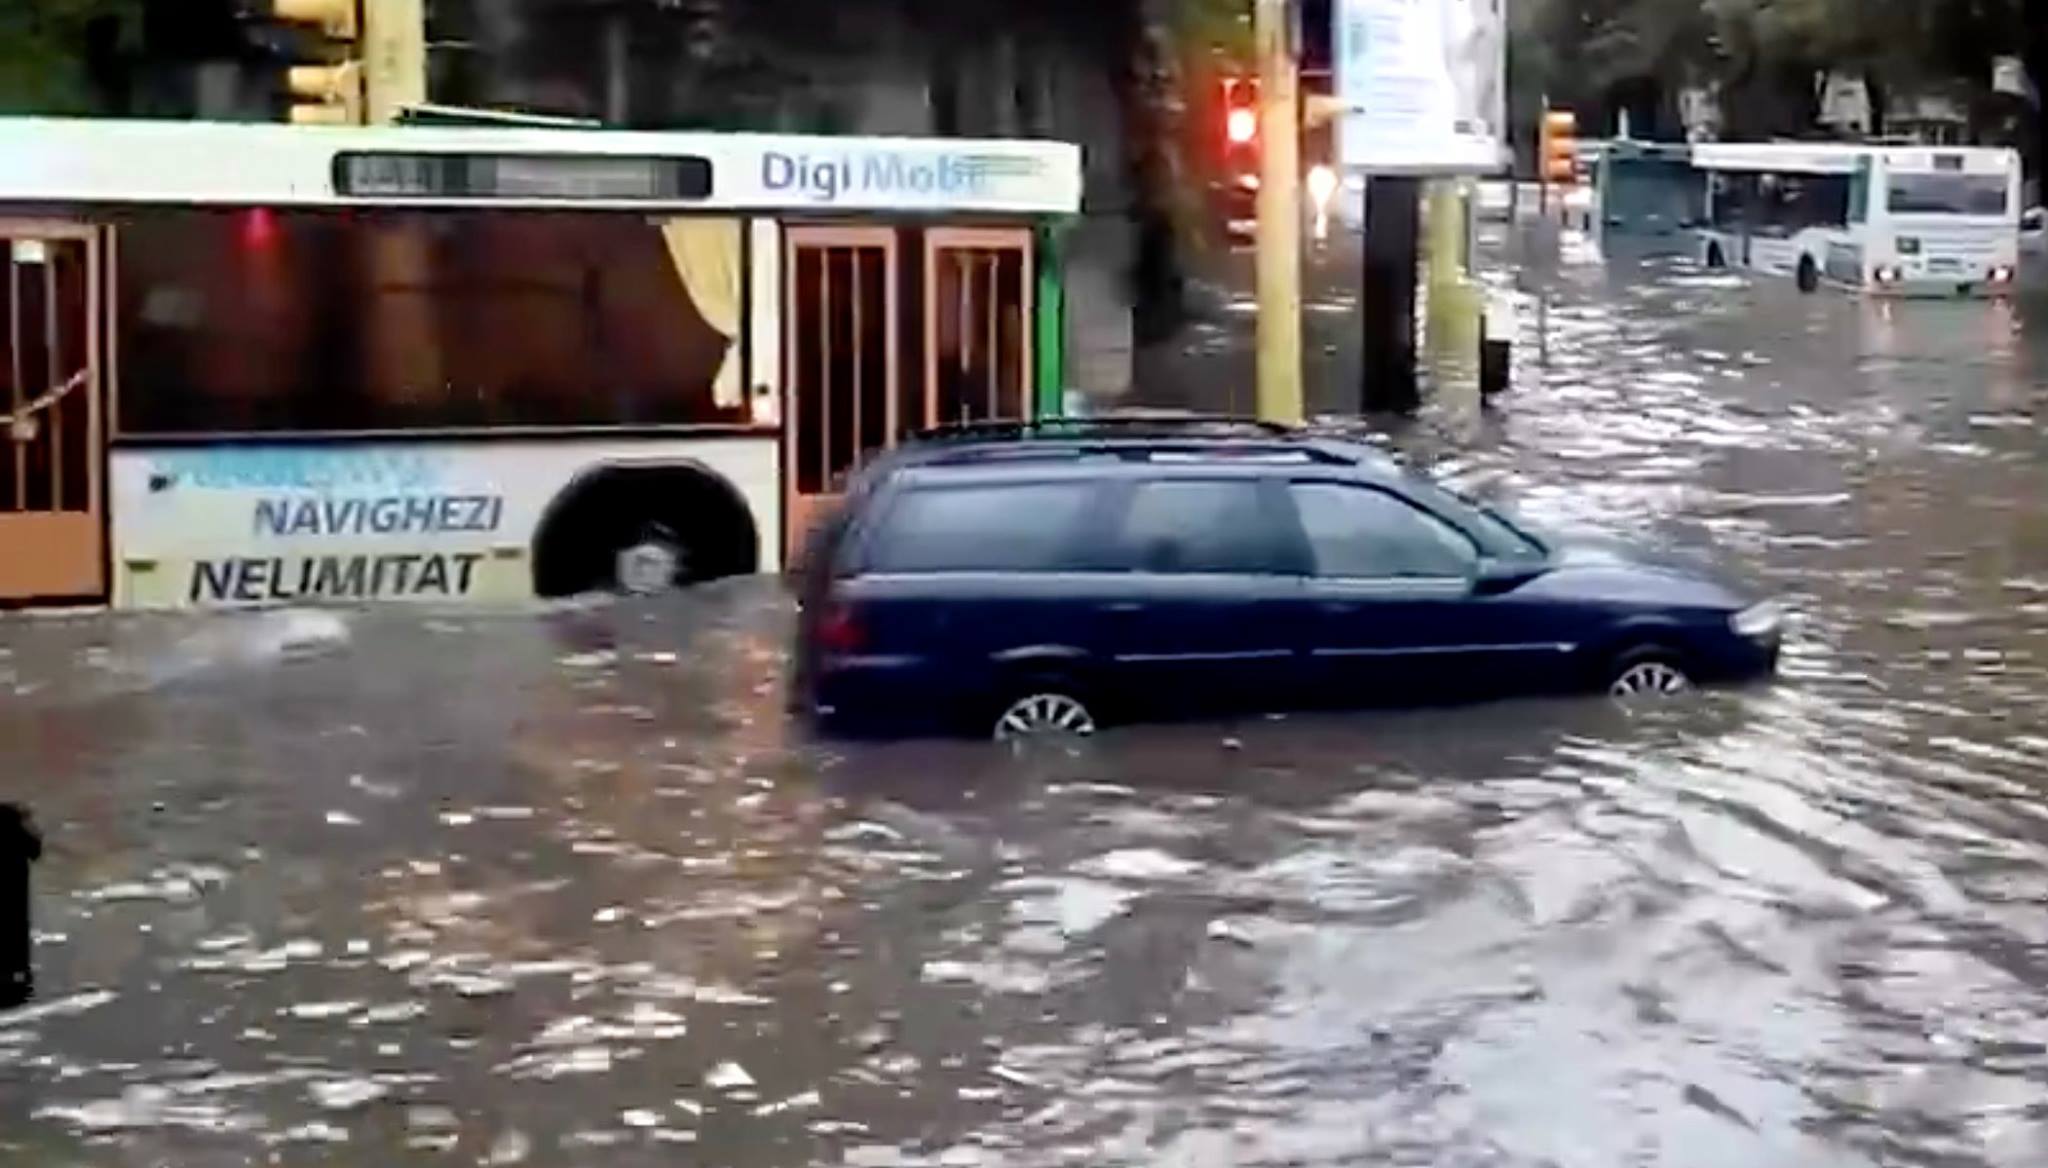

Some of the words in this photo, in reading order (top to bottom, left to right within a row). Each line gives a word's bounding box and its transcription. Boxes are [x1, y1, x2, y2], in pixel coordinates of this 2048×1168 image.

[761, 151, 850, 201] Digi
[254, 495, 504, 536] NAVIGHEZI
[190, 553, 484, 601] NELIMITAT
